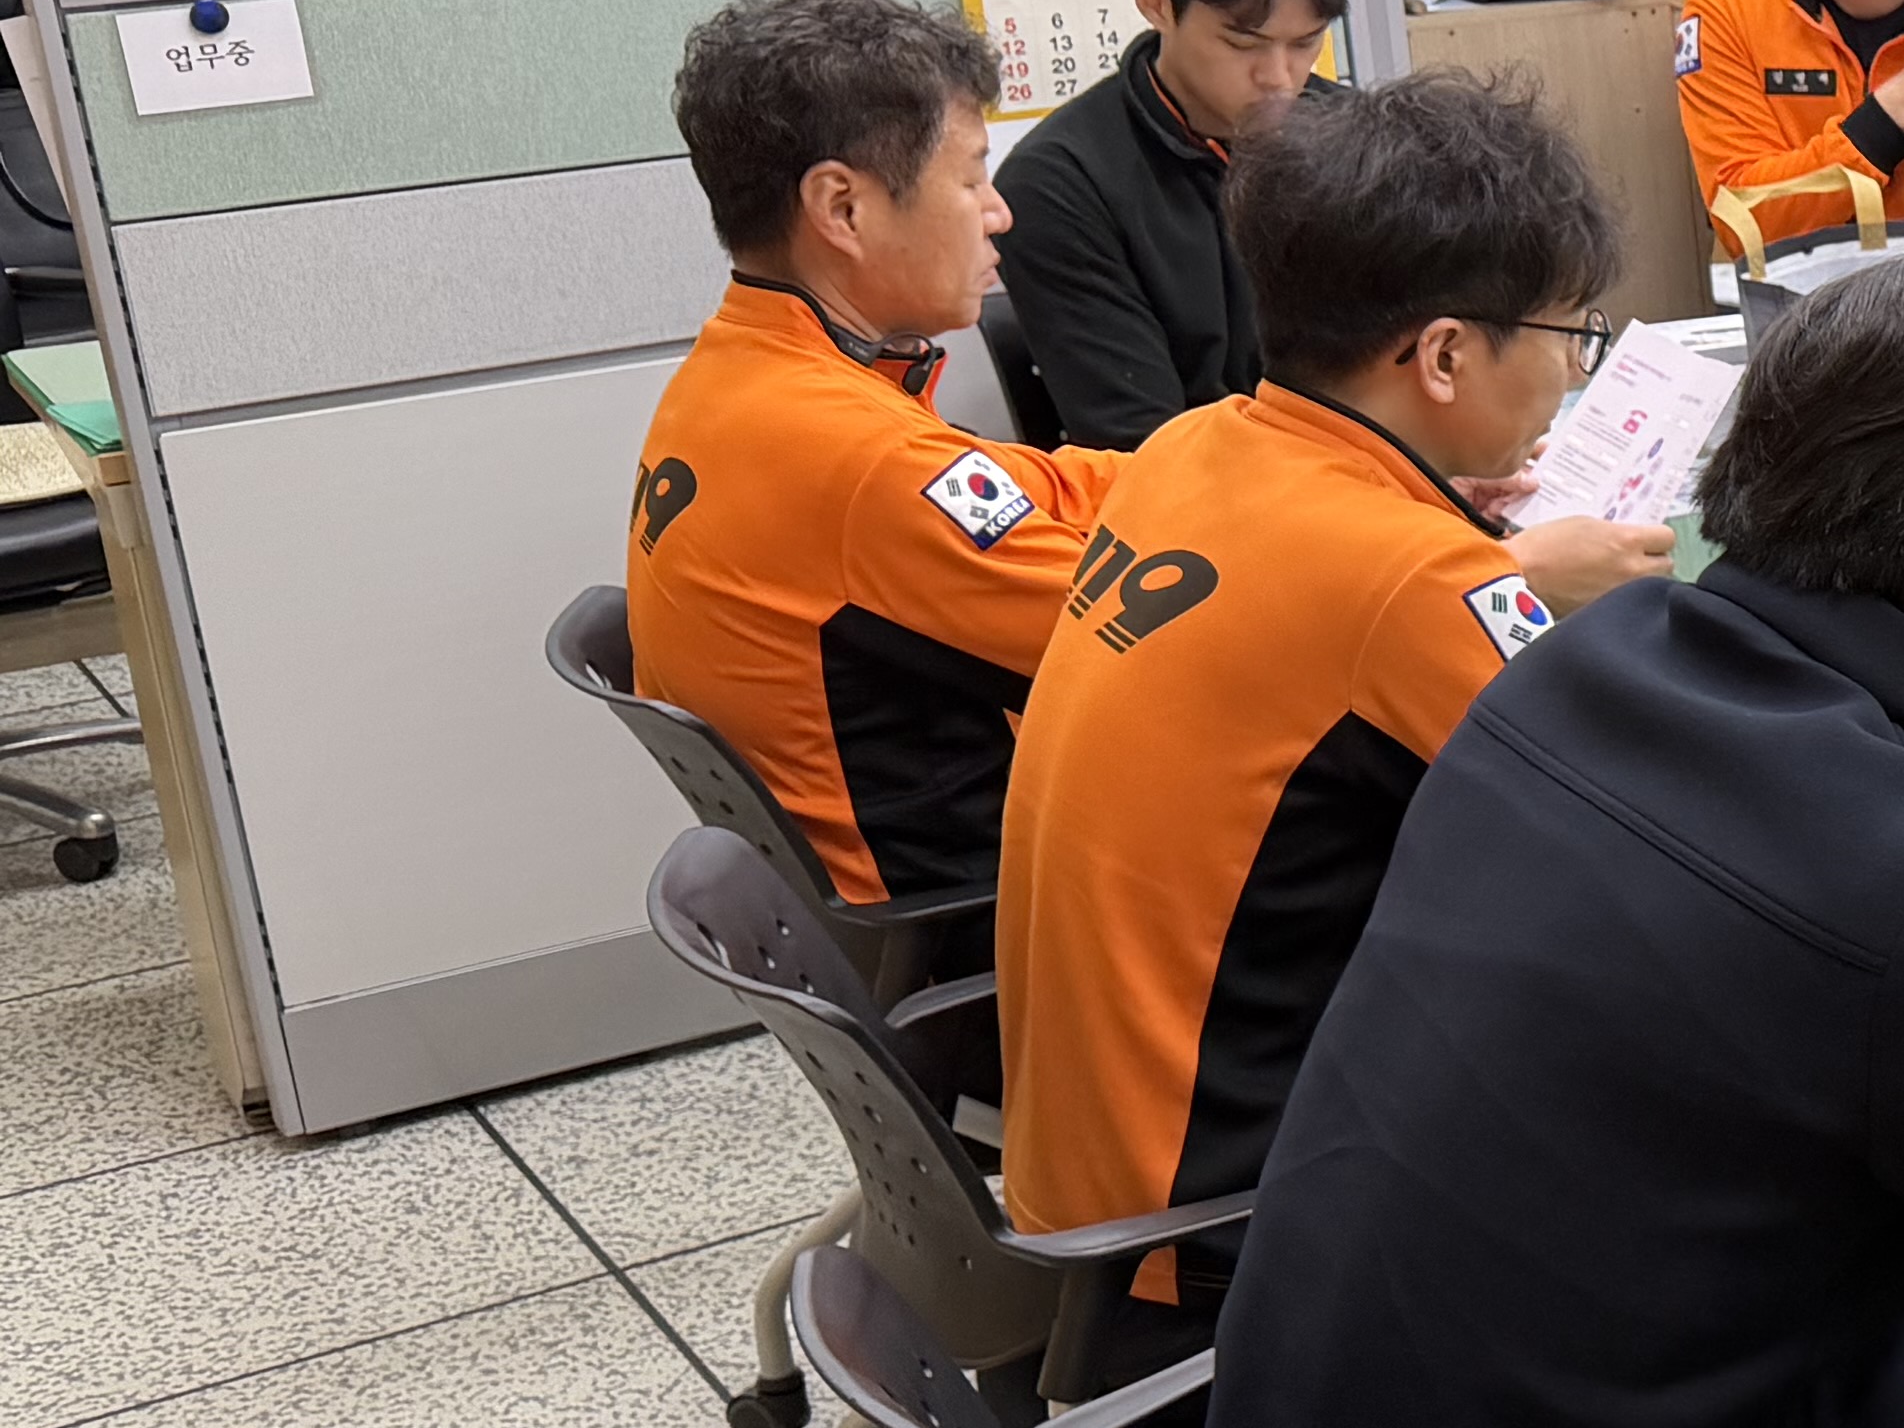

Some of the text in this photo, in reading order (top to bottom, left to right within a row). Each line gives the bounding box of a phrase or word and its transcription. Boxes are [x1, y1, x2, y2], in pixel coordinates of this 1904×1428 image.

[1004, 8, 1109, 34] 5 6 7
[166, 39, 255, 72] 업무중
[1002, 30, 1119, 56] 12 13 14
[1051, 56, 1076, 74] 20
[1006, 78, 1078, 102] 26 27
[631, 457, 698, 556] 19
[985, 497, 1032, 539] KOREA
[1066, 523, 1220, 655] 119
